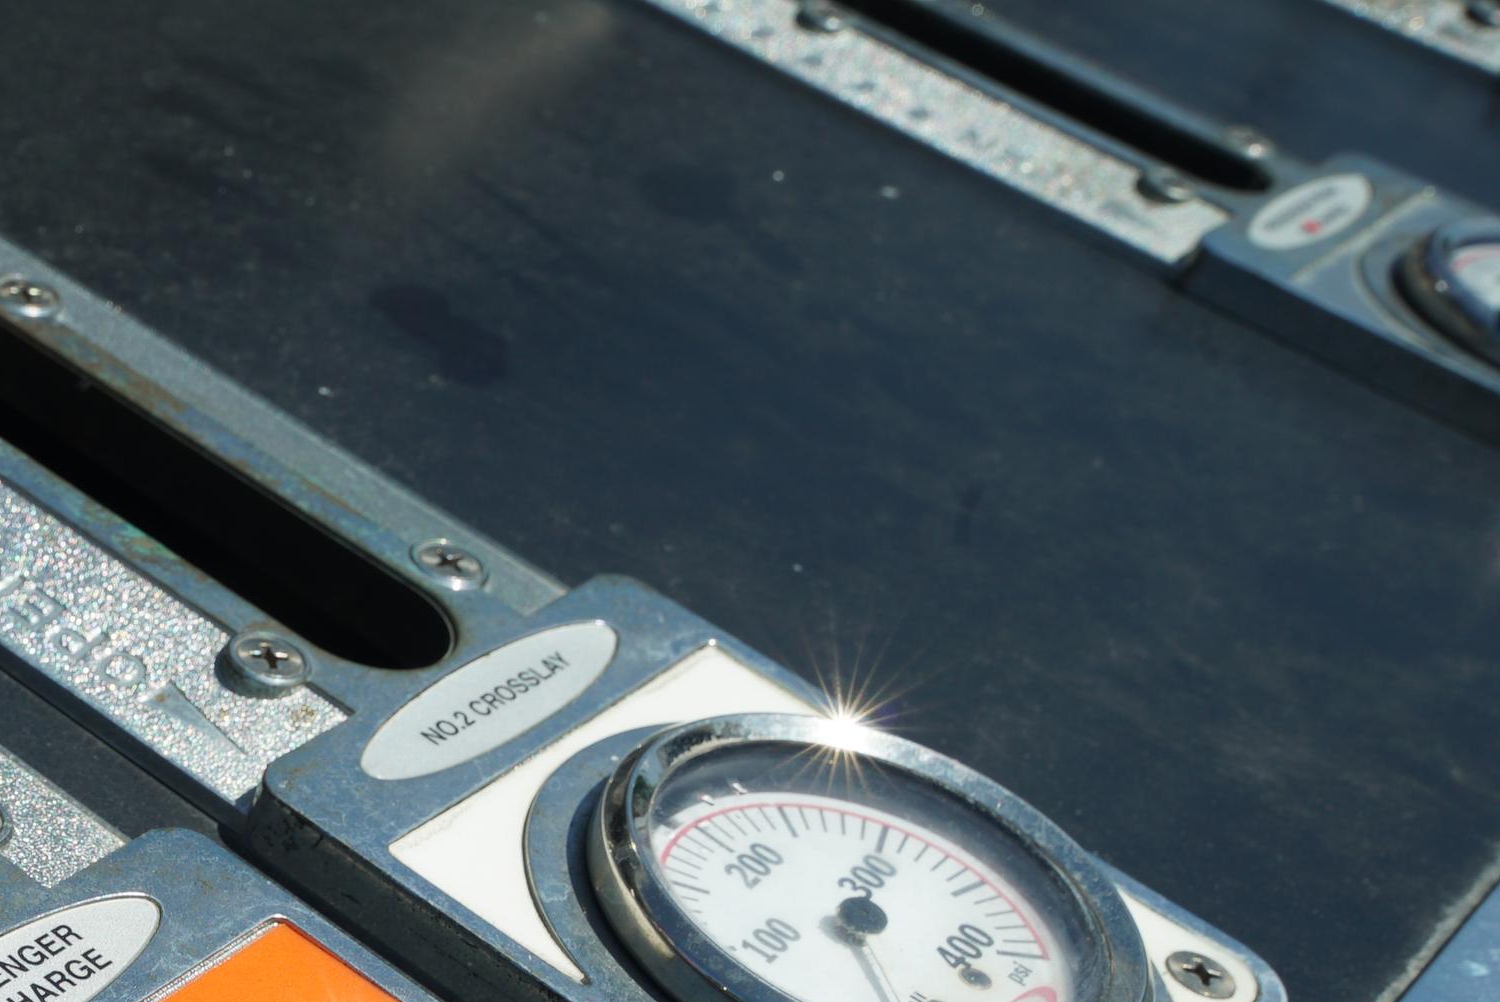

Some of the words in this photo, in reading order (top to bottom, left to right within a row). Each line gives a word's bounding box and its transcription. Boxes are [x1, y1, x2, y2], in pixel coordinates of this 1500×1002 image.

[420, 710, 476, 746] NO.2
[469, 651, 572, 717] CROSSLAY
[724, 842, 784, 890] 200
[837, 853, 898, 901] 300
[741, 917, 802, 965] 100
[935, 923, 995, 971] 400
[1007, 960, 1034, 987] psi
